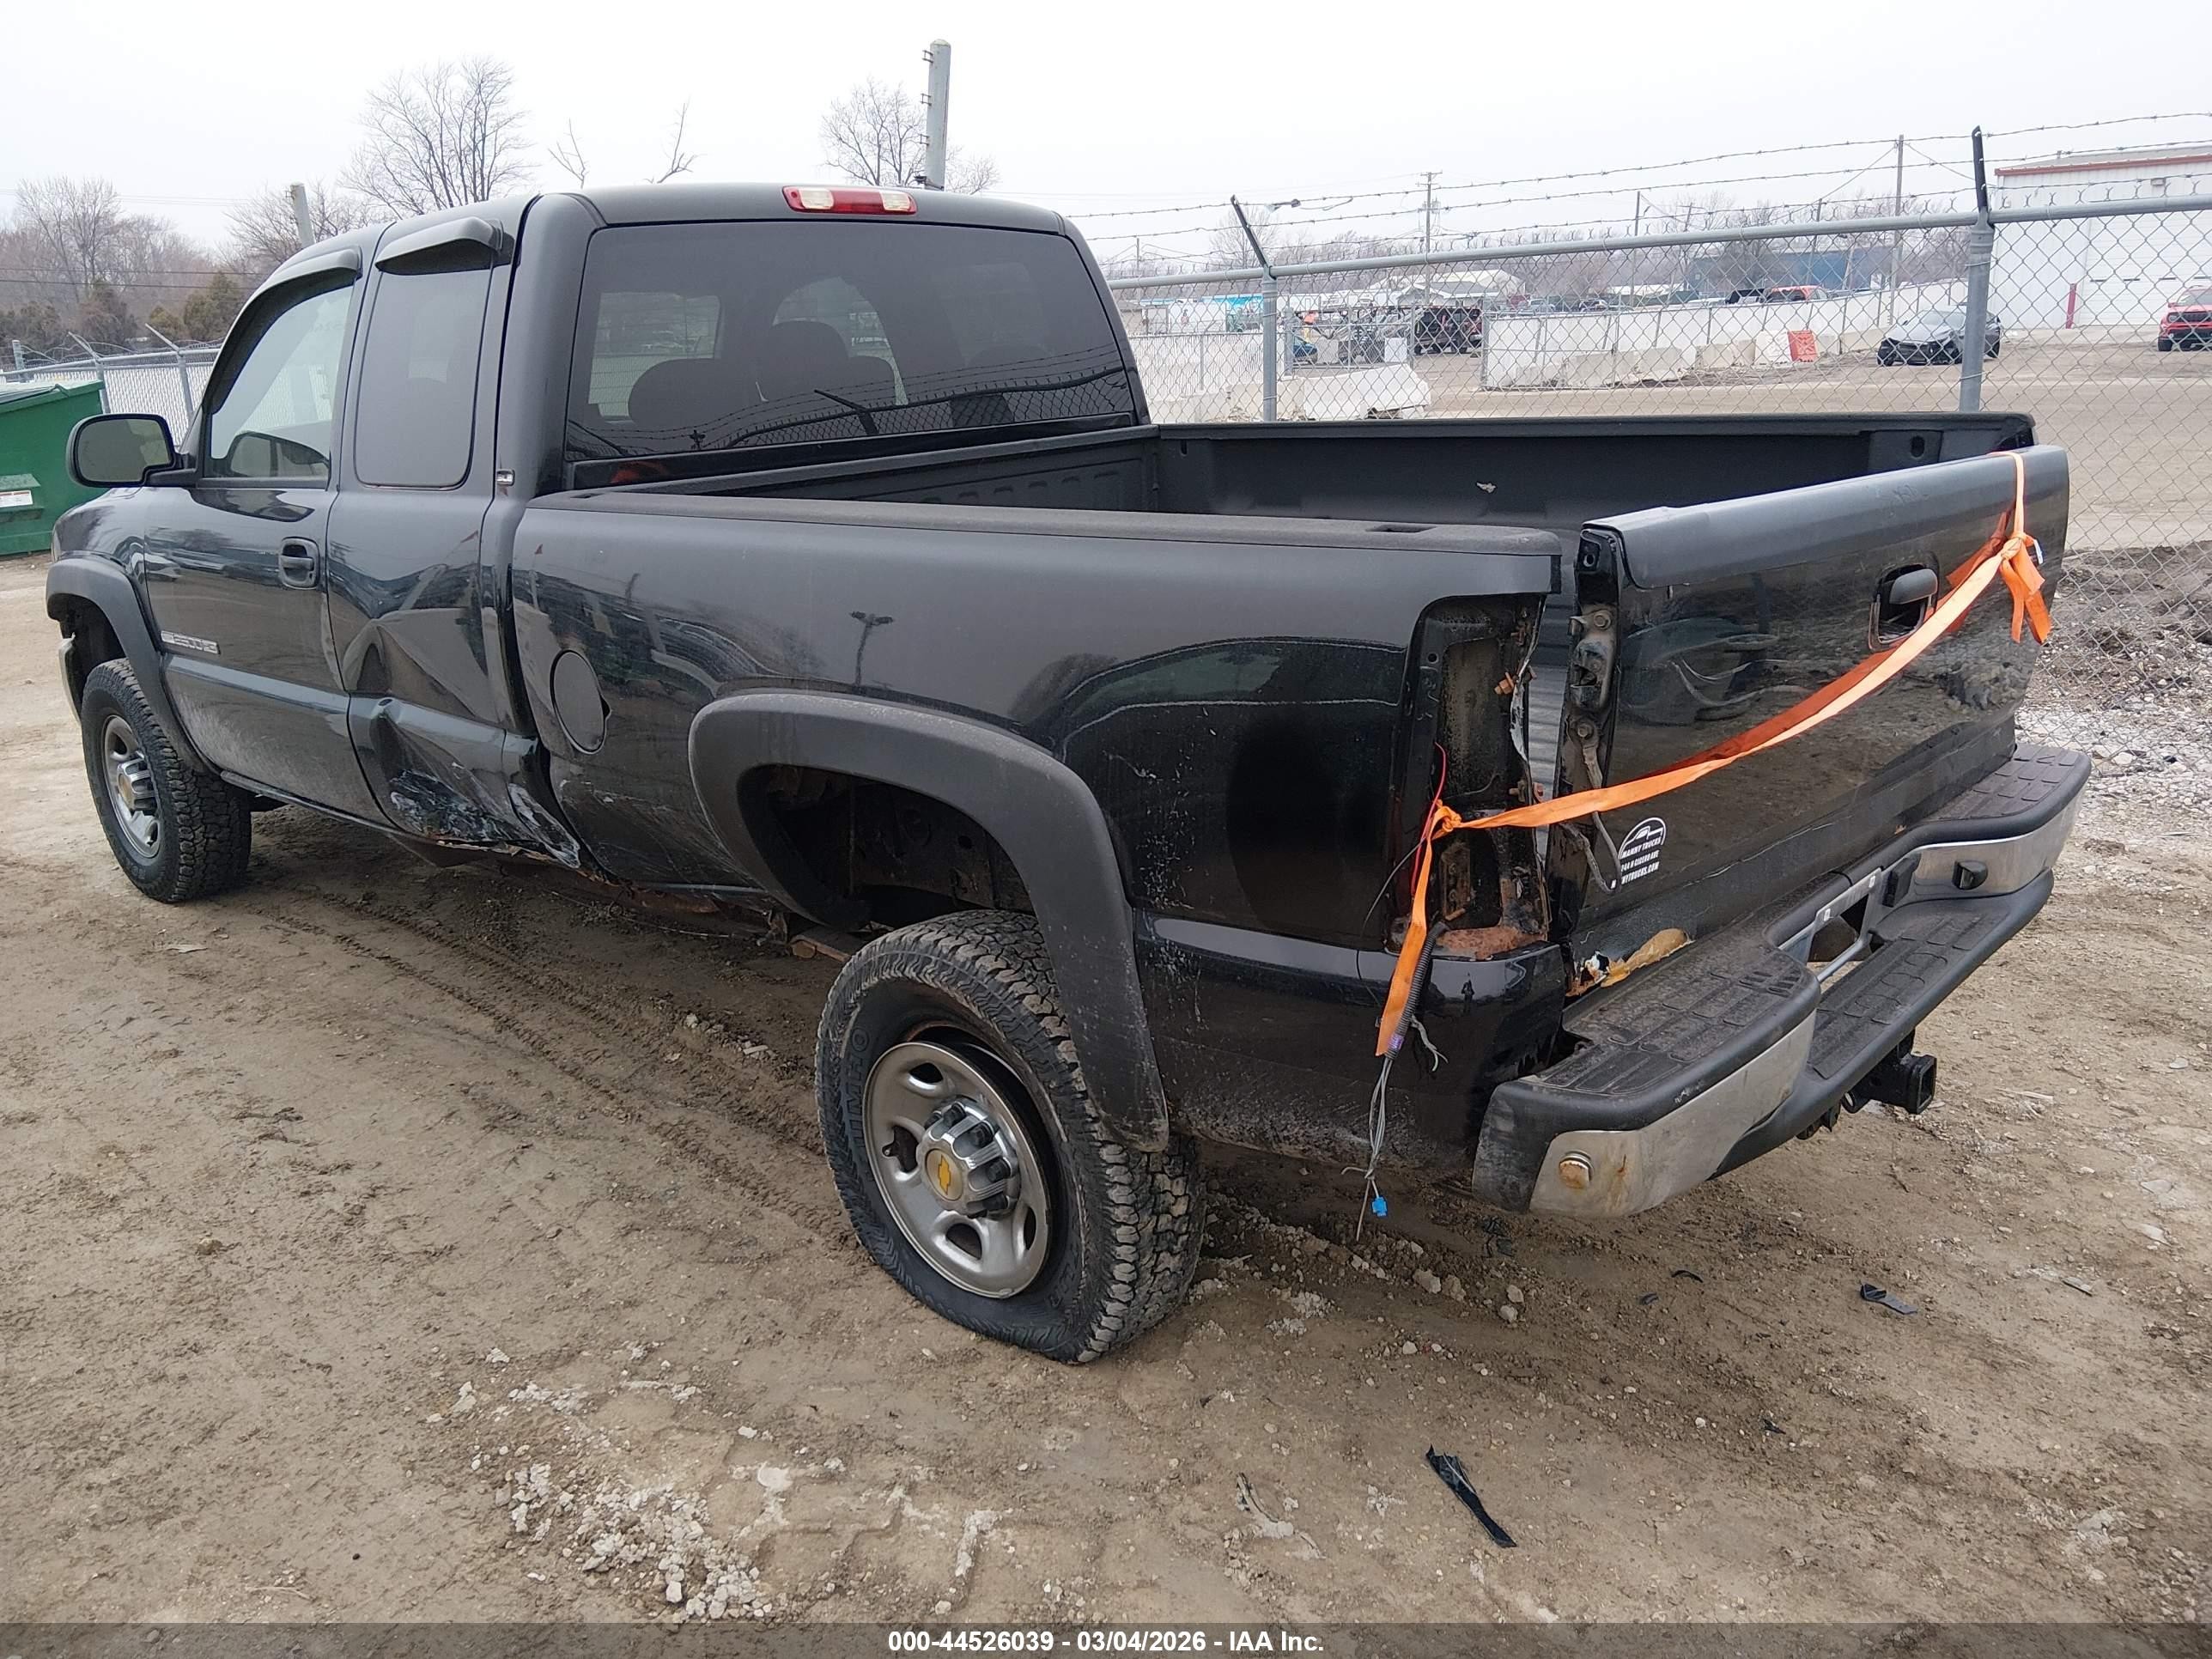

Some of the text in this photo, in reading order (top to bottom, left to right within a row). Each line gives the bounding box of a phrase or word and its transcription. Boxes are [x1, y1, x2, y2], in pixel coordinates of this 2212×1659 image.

[1621, 836, 1661, 859] MANNY TRUCKS
[1650, 849, 1660, 860] AVE
[1611, 861, 1660, 889] MNYTRUCKS.COM
